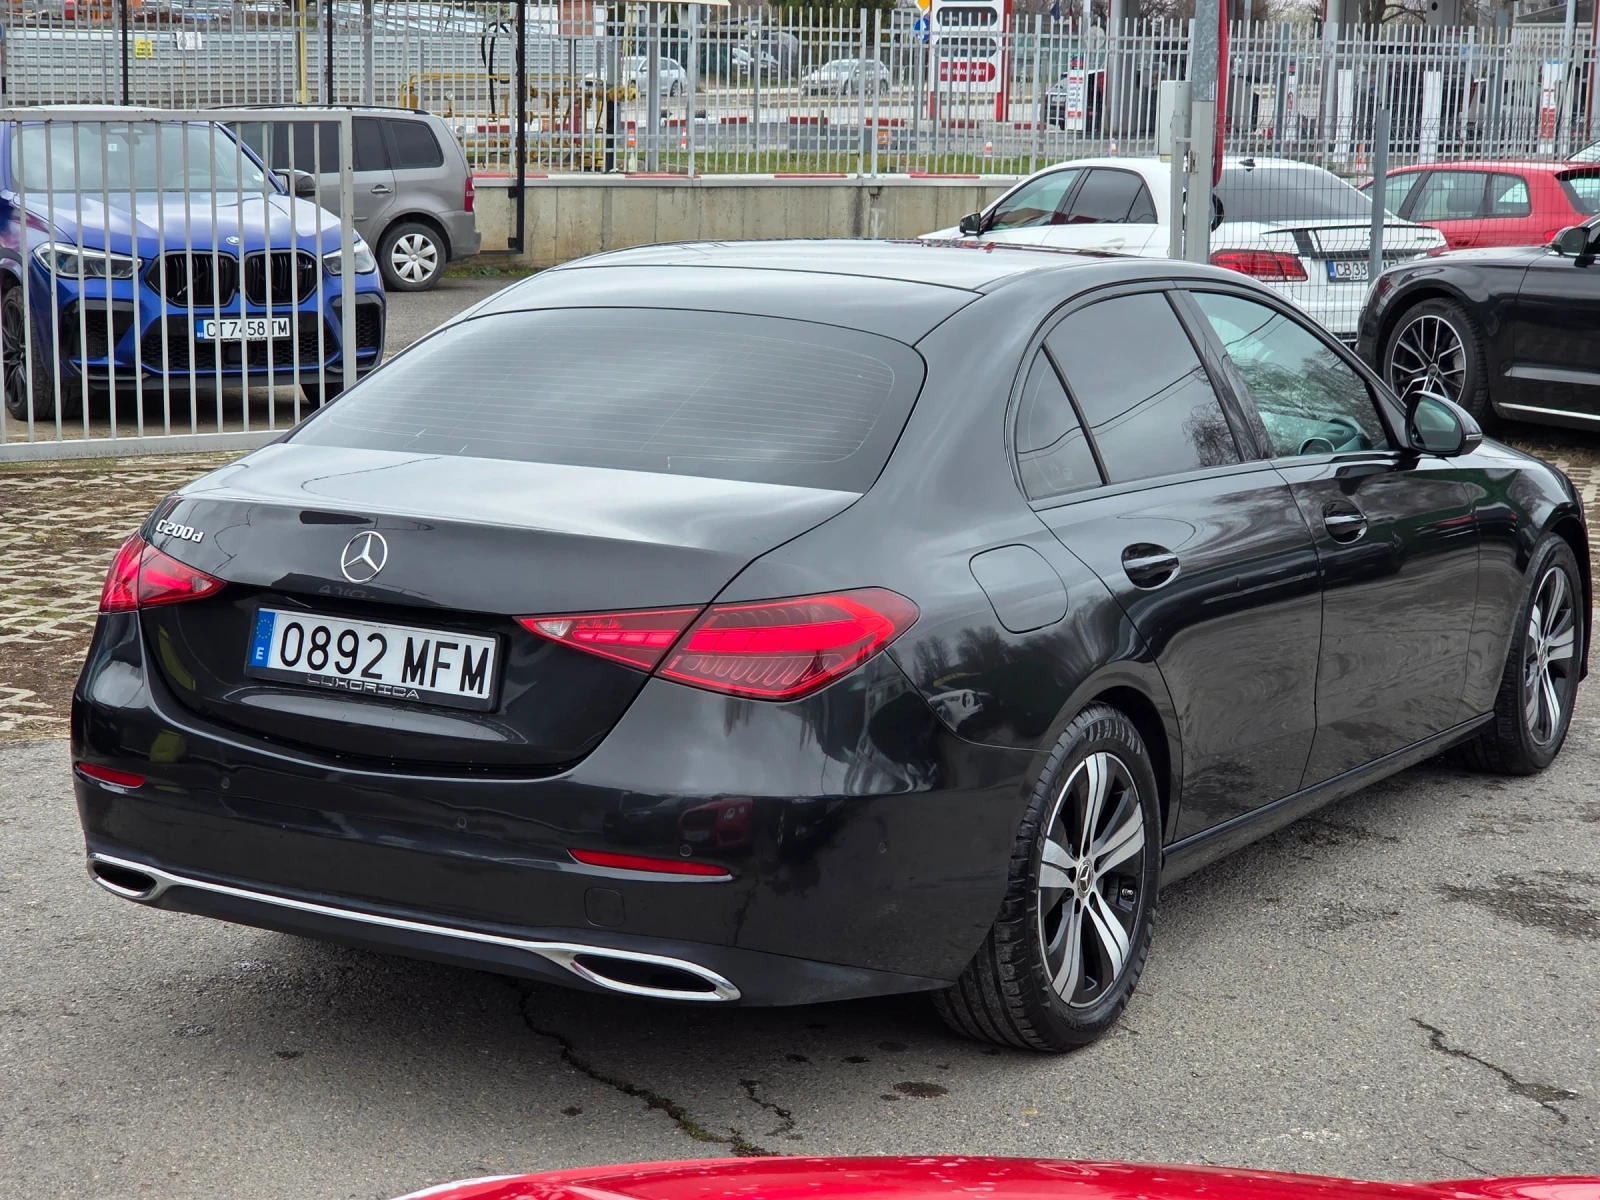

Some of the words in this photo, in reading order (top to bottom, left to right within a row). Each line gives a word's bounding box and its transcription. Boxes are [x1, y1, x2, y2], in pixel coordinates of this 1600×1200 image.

[1353, 262, 1369, 276] 33
[156, 519, 205, 544] C200d
[255, 647, 264, 660] E
[279, 621, 389, 681] 0892
[401, 636, 490, 695] MFM
[306, 674, 420, 700] LUXORICA
